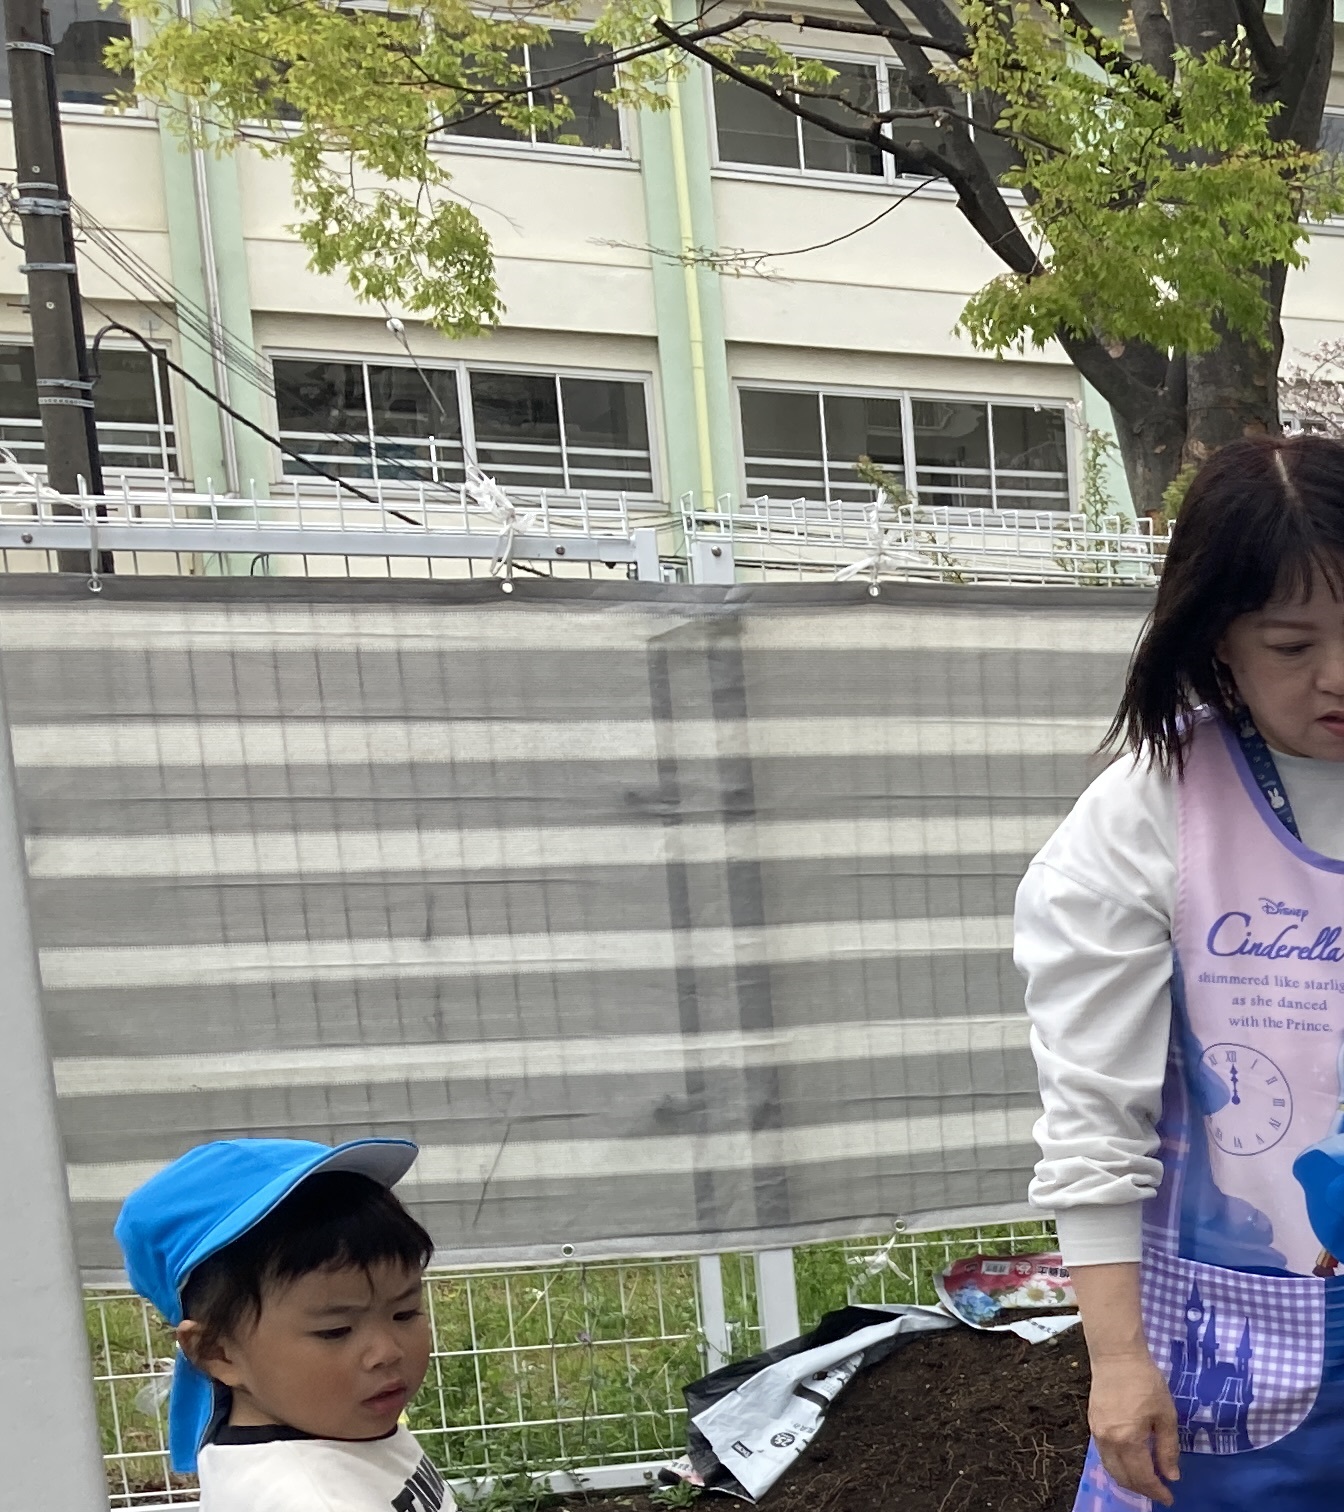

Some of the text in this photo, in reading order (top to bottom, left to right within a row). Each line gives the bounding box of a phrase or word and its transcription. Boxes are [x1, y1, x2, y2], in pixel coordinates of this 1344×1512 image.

[1198, 972, 1270, 986] shimmered
[1274, 975, 1300, 989] like
[1231, 995, 1328, 1011] as she danced
[1228, 1016, 1333, 1032] with the Prince.
